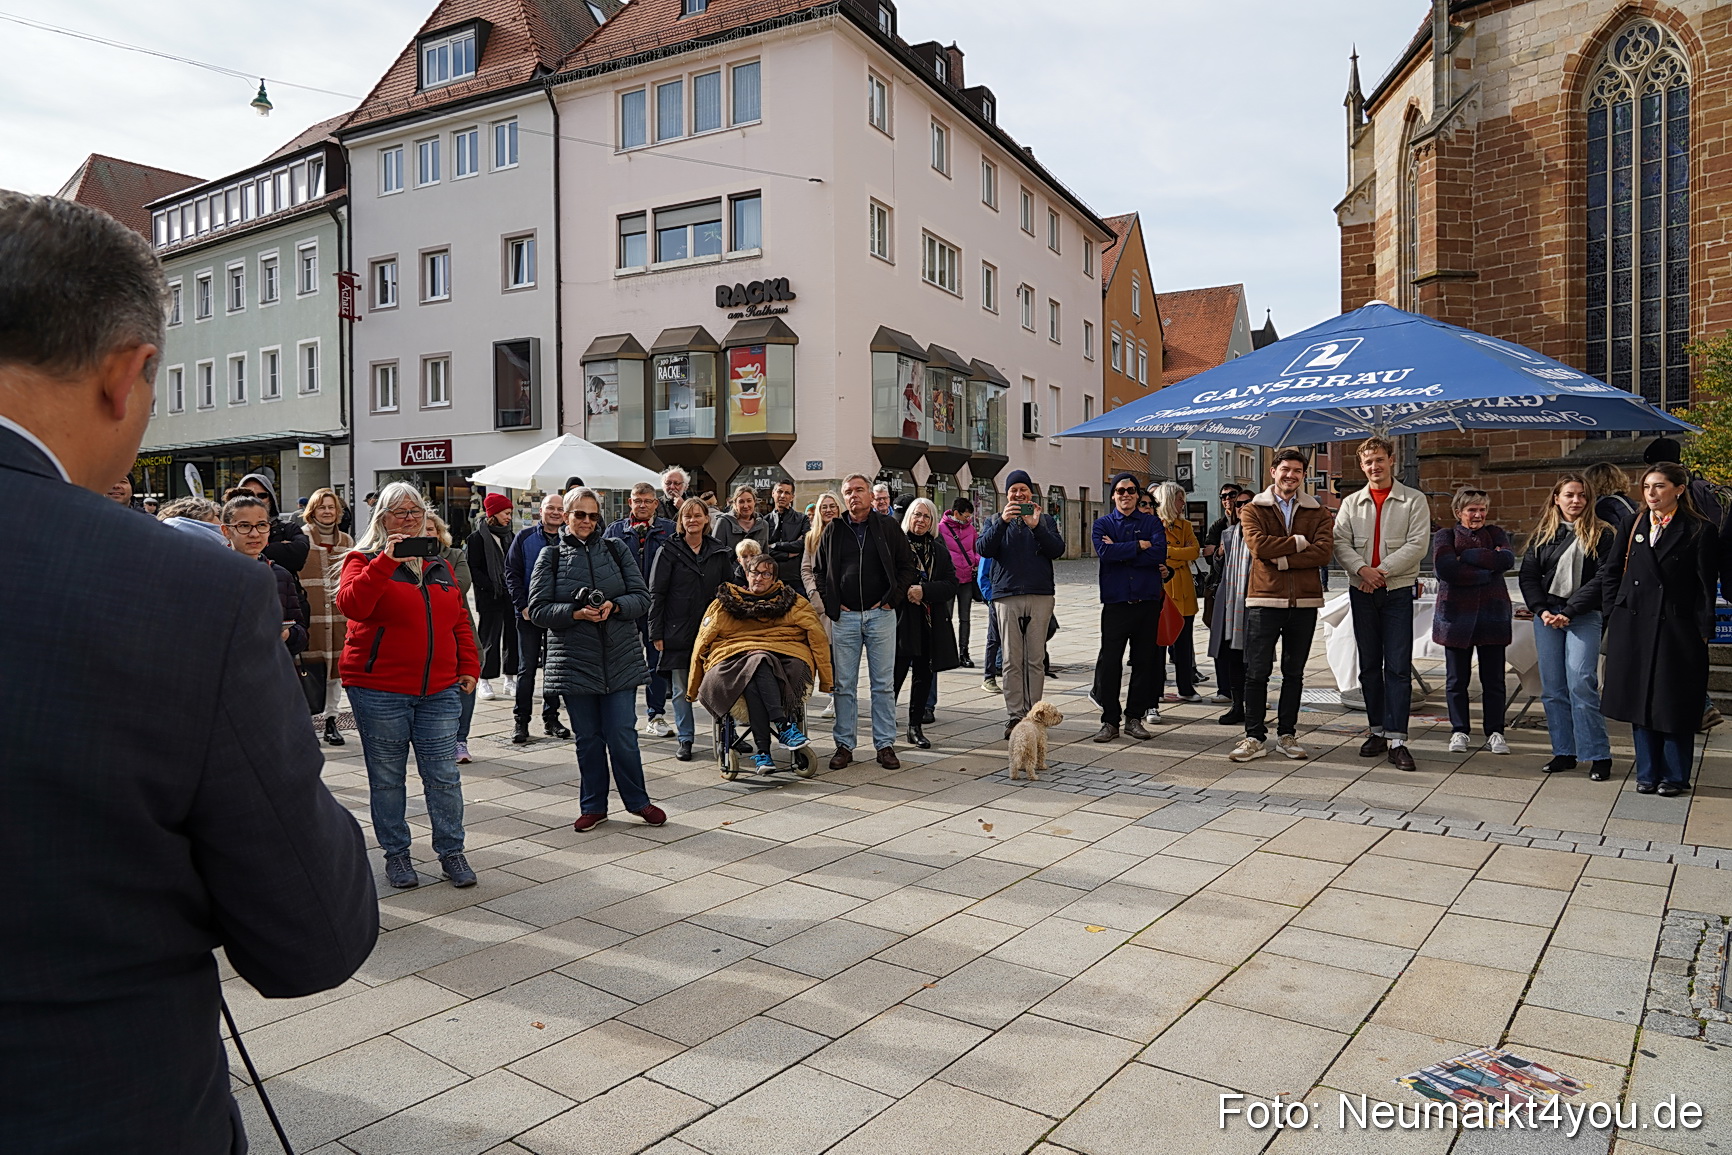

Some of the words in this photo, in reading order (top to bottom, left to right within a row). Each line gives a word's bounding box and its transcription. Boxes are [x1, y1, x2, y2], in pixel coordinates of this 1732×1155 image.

[341, 281, 351, 316] Achatz
[716, 277, 796, 308] RACKL
[727, 312, 744, 320] am
[745, 304, 789, 318] Rathaus
[658, 364, 681, 380] RACKL
[1192, 367, 1416, 404] GANSBRÄU
[1134, 396, 1266, 424] Neumarkt's
[1266, 392, 1336, 408] guter
[1328, 383, 1444, 403] Schluck
[404, 442, 446, 463] Achatz
